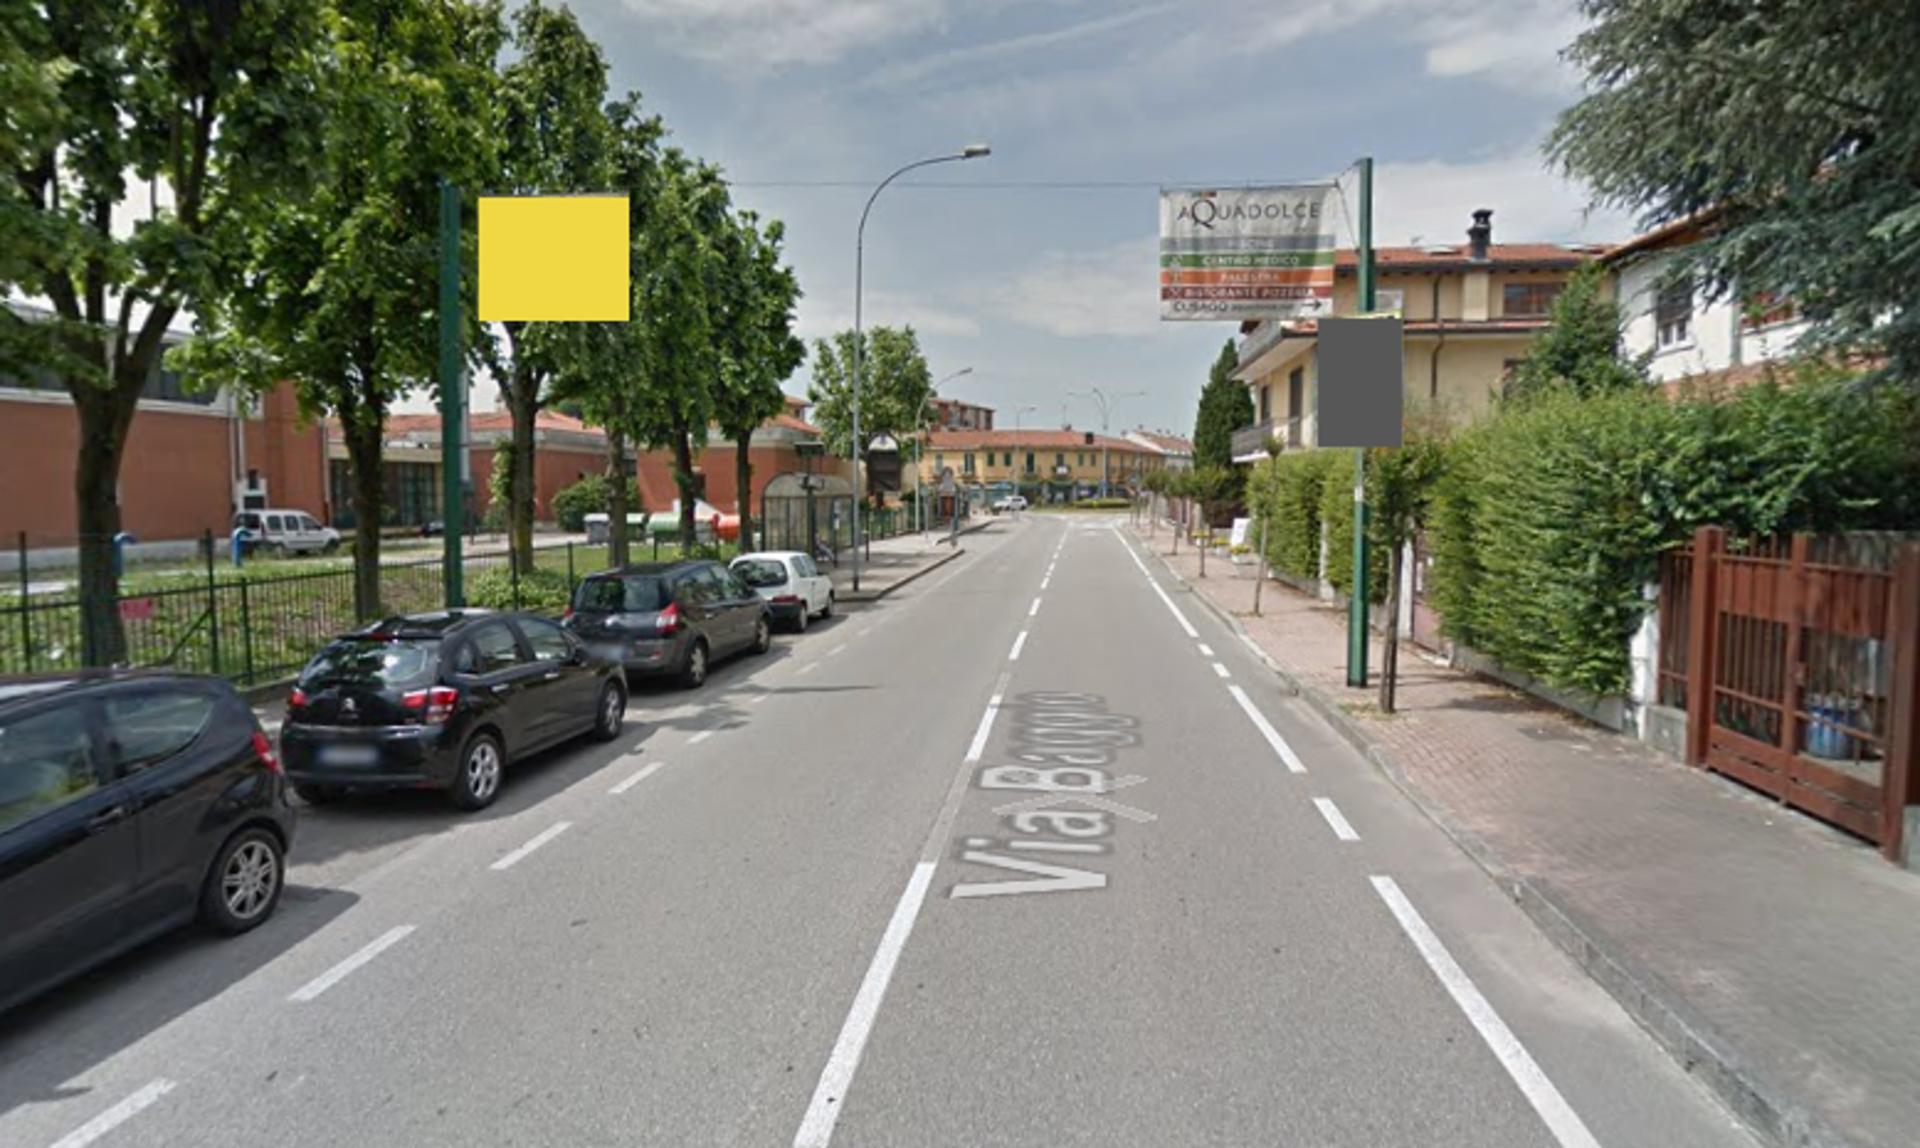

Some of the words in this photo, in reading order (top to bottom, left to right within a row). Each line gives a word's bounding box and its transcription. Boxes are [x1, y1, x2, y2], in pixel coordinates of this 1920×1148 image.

[1177, 199, 1322, 229] AQUADOLCE
[1202, 256, 1251, 266] CENTRO
[1253, 255, 1300, 265] MEDICO
[1220, 272, 1281, 283] PALESTRA
